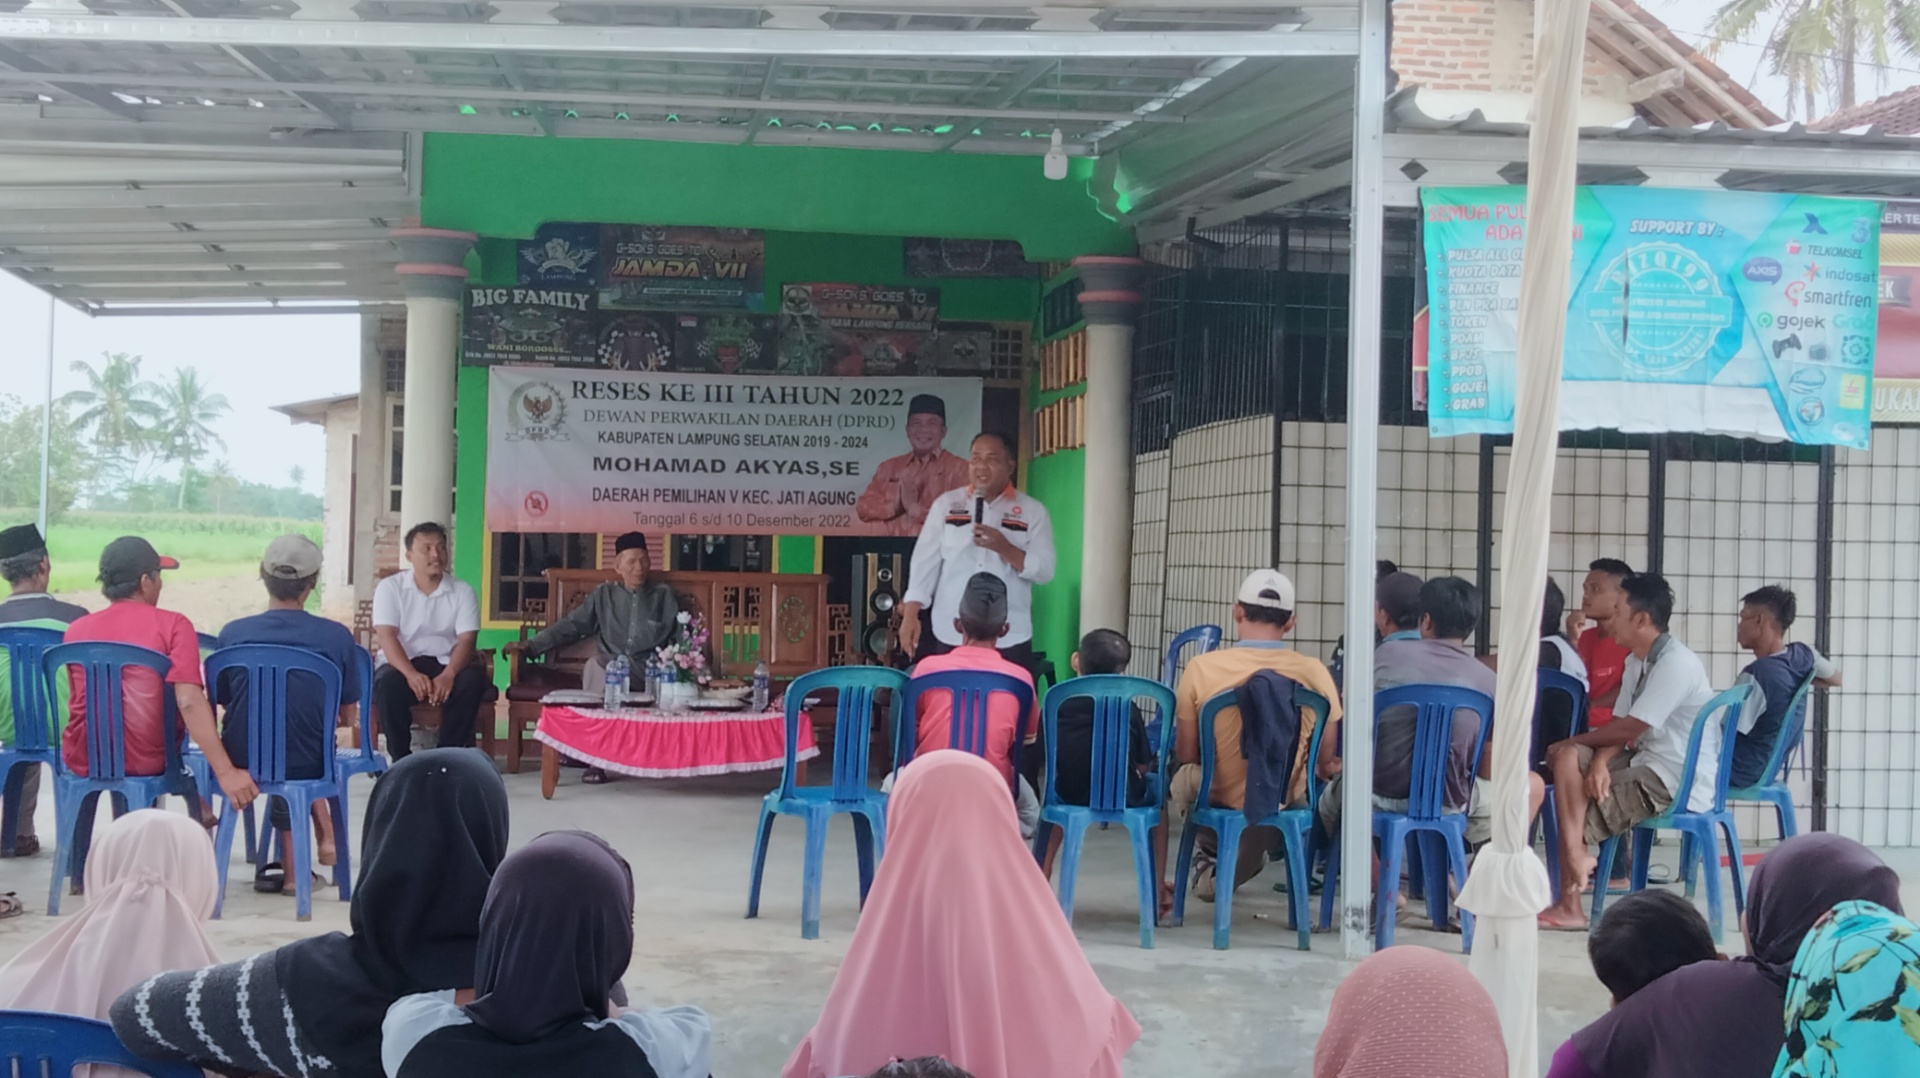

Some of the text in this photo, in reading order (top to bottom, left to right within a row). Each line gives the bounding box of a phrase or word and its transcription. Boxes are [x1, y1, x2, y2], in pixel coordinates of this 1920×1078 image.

[1428, 204, 1527, 222] SEMUA PUL
[1485, 224, 1523, 240] ADA
[1629, 219, 1694, 235] SUPPORT
[1697, 222, 1717, 236] BY
[657, 244, 684, 255] GOES
[689, 245, 702, 256] TO
[1447, 249, 1486, 262] PULSA
[1487, 249, 1509, 262] ALL
[1808, 244, 1863, 260] TELKOMSEL
[611, 257, 748, 279] JAMDA VII
[1447, 264, 1522, 278] KUOTA DATA
[1747, 265, 1778, 277] AXIS
[1825, 268, 1878, 283] indosat
[821, 288, 927, 303] G-SOKS GOES TO
[1448, 282, 1499, 295] FINANCE
[471, 288, 590, 311] BIG FAMILY
[1449, 299, 1472, 311] PLN
[1474, 299, 1498, 311] PRA
[1803, 290, 1872, 309] smartfren
[852, 319, 893, 329] LAMPUNG
[1449, 316, 1488, 328] TOKEN
[1776, 315, 1826, 332] gojek
[1449, 333, 1484, 345] PDAM
[487, 343, 514, 352] WANI
[1450, 349, 1481, 361] BPJS
[1450, 365, 1483, 378] PPOB
[571, 380, 904, 406] RESES KE III TAHUN 2022
[1452, 398, 1486, 411] GRAB
[583, 409, 896, 431] DEWAN PERWAKILAN DAERAH (DPRD)
[597, 431, 674, 445] KABUPATEN
[678, 433, 740, 446] LAMPUNG
[744, 434, 800, 447] SELATAN
[804, 435, 830, 448] 2019
[841, 436, 869, 448] 2024
[592, 457, 860, 478] MOHAMAD AKYAS,SE
[592, 487, 856, 506] DAERAH PEMILIHAN V KEC. JATI AGUNG
[632, 511, 851, 527] Tanggal 6 s/d 10 Desember 2022
